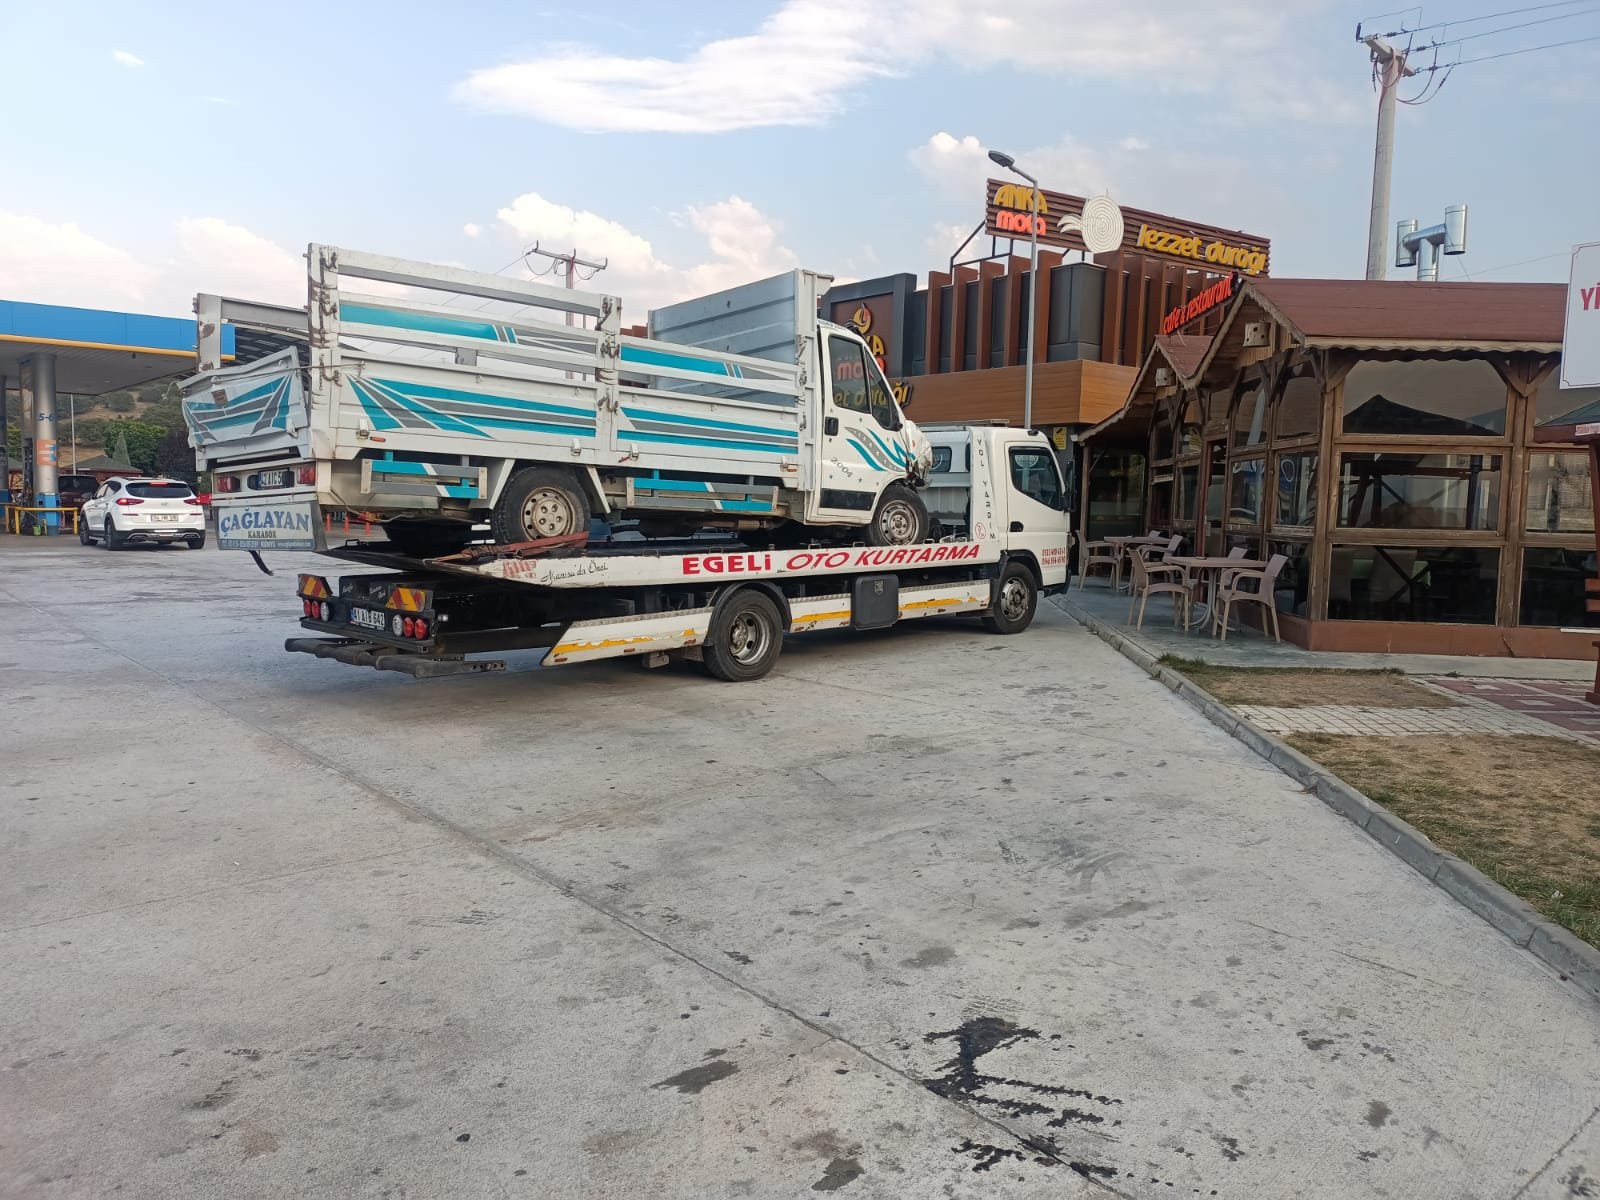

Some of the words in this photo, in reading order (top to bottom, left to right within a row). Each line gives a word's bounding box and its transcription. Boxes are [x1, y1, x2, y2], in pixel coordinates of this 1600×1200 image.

[1136, 224, 1202, 259] lezzet
[1205, 241, 1267, 276] durağı
[1186, 270, 1233, 322] restaurant
[220, 507, 310, 537] ÇAĞLAYAN
[786, 551, 850, 571] OTO
[854, 543, 981, 566] KURTARMA
